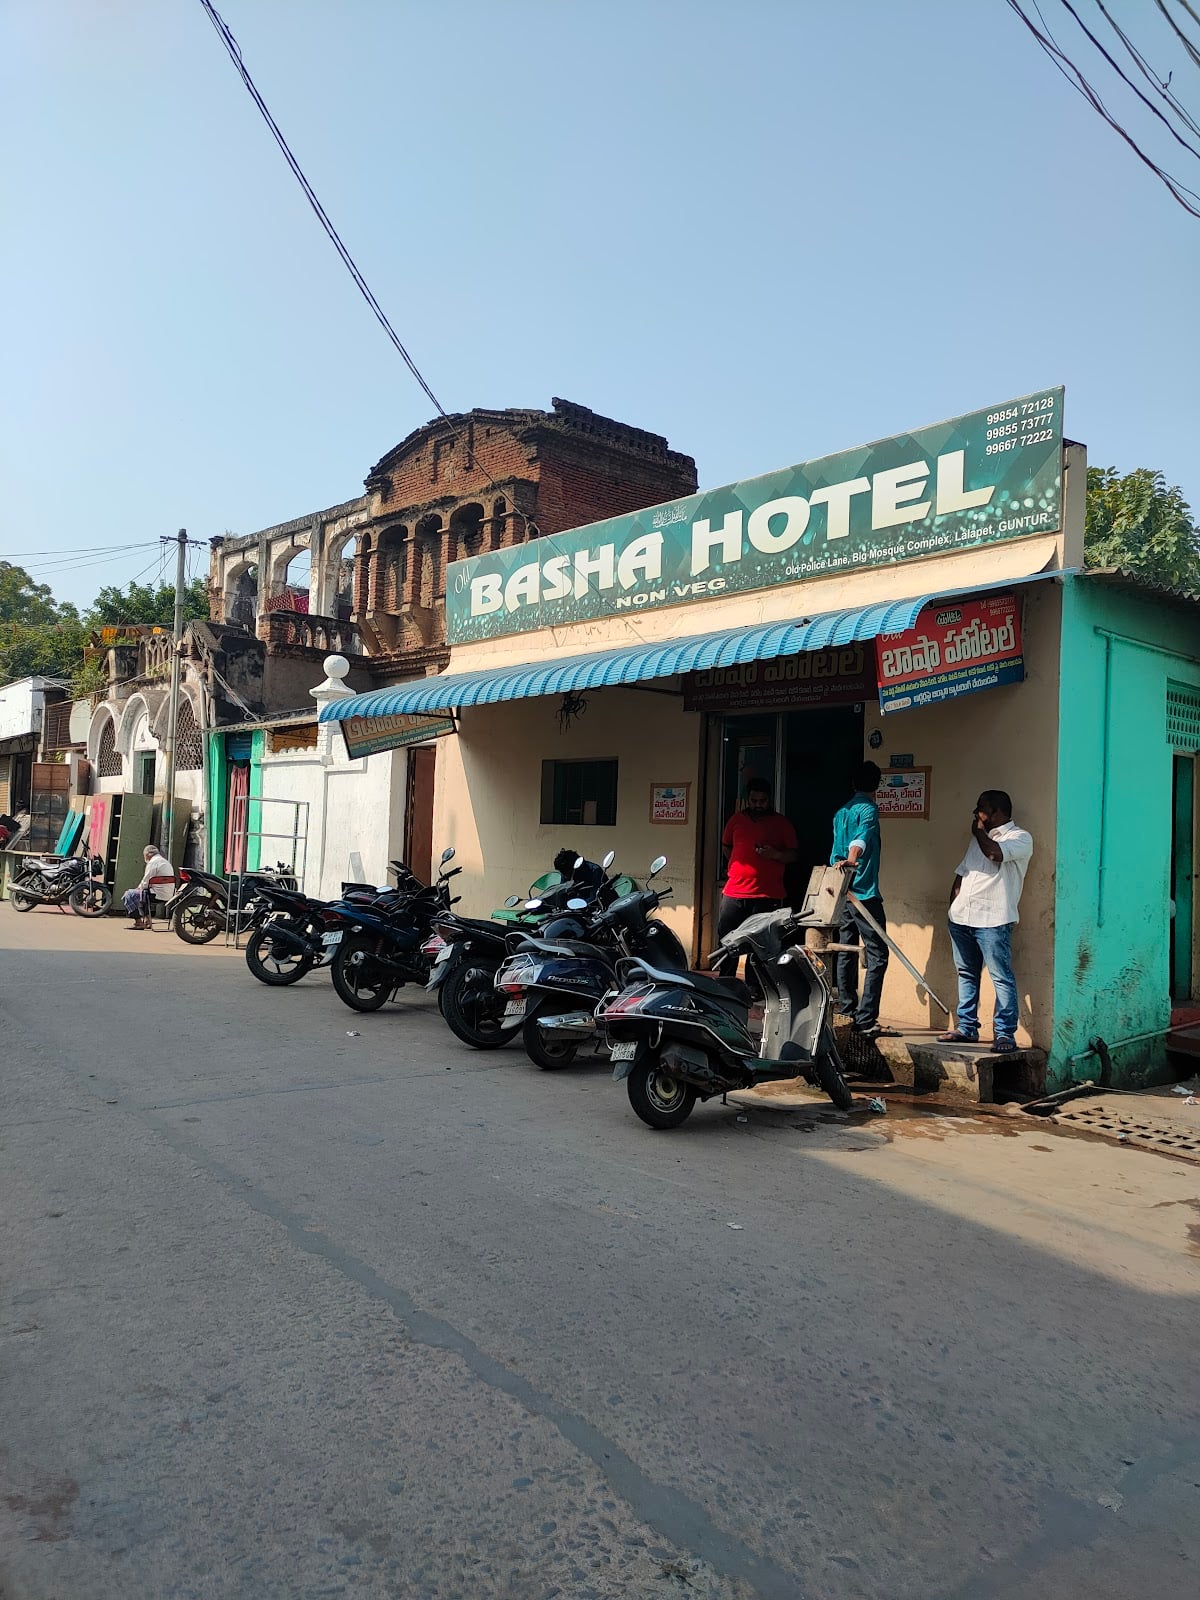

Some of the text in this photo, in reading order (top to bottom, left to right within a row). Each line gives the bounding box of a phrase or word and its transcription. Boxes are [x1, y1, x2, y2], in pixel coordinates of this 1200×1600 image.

[986, 412, 1054, 440] 99855 73777
[987, 397, 1054, 425] 99854 72128
[986, 429, 1053, 456] 99667 72222
[470, 449, 996, 617] BASHA HOTEL
[827, 556, 850, 567] Lane,
[852, 552, 867, 562] Big
[869, 543, 905, 559] Mosque
[907, 533, 952, 550] Complex,
[955, 523, 995, 541] Lalapet,
[616, 578, 727, 609] NON VEG
[882, 635, 941, 678] బాషా
[943, 615, 1016, 664] హోటల్
